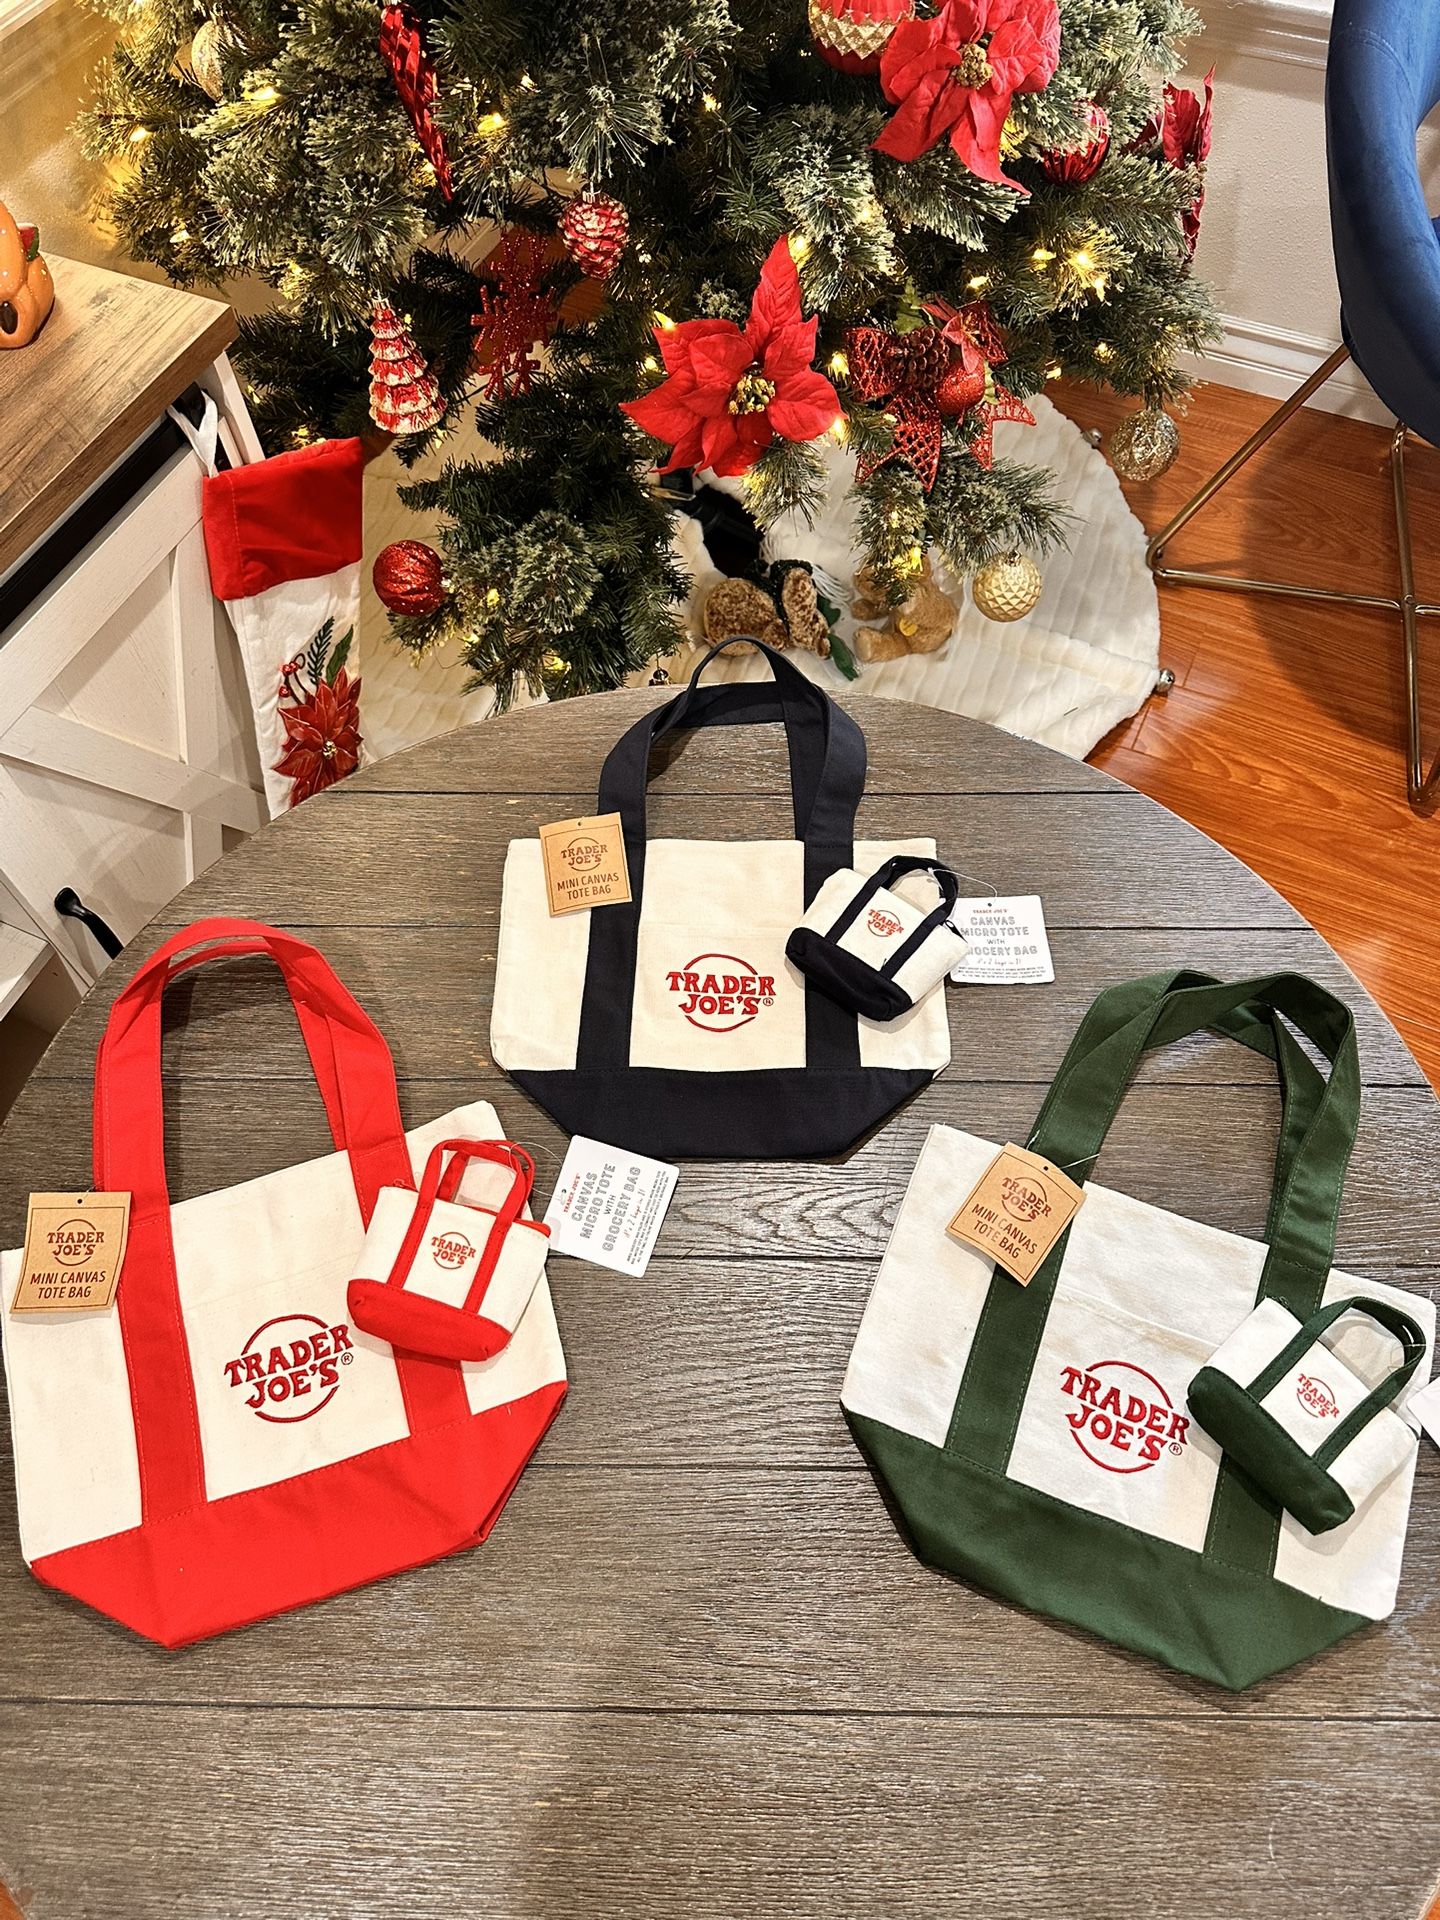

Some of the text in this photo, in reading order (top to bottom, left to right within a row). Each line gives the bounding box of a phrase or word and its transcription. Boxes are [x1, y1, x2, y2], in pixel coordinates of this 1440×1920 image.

[561, 844, 608, 859] TRADER
[568, 854, 602, 866] JOE'S
[557, 872, 620, 891] MINI CANVAS
[567, 884, 612, 901] TOTE BAG
[868, 909, 904, 934] TRADER
[868, 919, 895, 936] JOE'S
[960, 926, 1030, 937] MICRO TOTE
[970, 916, 1016, 926] CANVAS
[1014, 945, 1038, 956] BAG
[665, 971, 777, 996] TRADER
[571, 1172, 598, 1222] CANVAS
[579, 1163, 616, 1239] MICRO TOTE
[603, 1194, 617, 1215] WITH
[1001, 1177, 1052, 1218] TRADER
[1001, 1193, 1041, 1221] JOE'S
[602, 1166, 641, 1252] GROCERY BAG
[47, 1231, 105, 1244] TRADER
[971, 1203, 1038, 1255] MINI CANVAS
[973, 1219, 1022, 1260] TOTE BAG
[52, 1244, 96, 1256] JOE'S
[431, 1236, 476, 1258] TRADER
[432, 1248, 467, 1265] JOE'S
[30, 1270, 106, 1285] MINI CANVAS
[38, 1285, 92, 1299] TOTE BAG
[223, 1324, 354, 1387] TRADER
[1060, 1366, 1190, 1445] TRADER
[1296, 1387, 1329, 1418] JOE'S
[1297, 1373, 1340, 1418] TRADER
